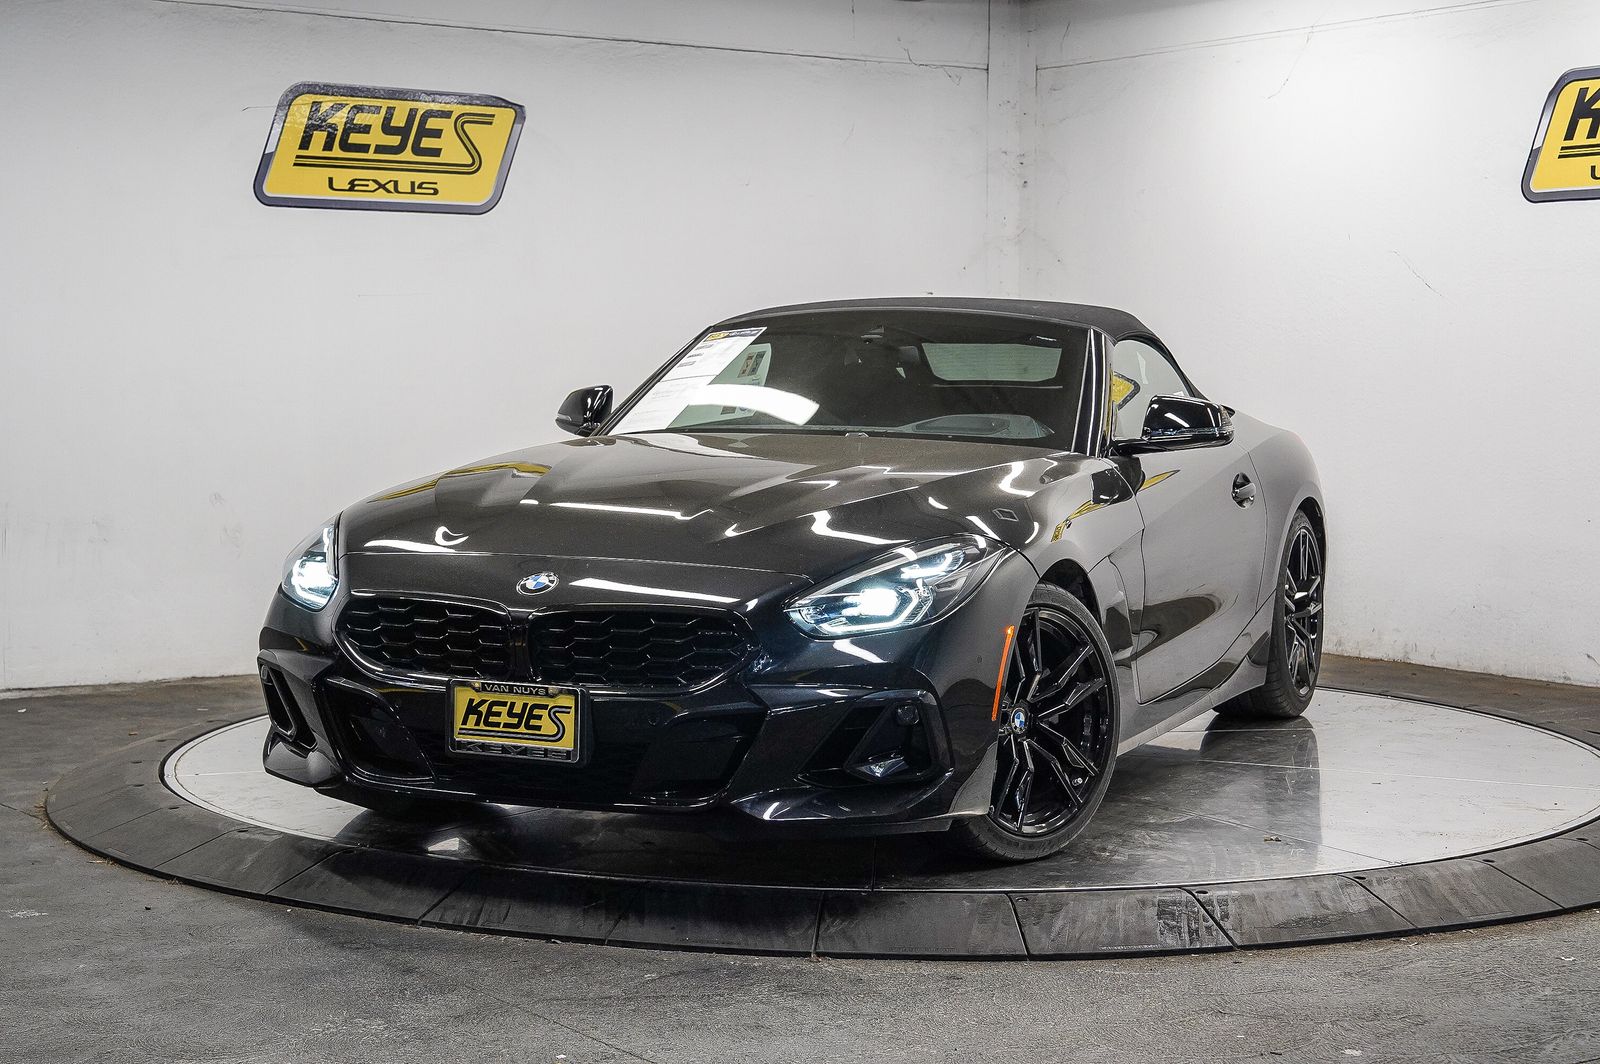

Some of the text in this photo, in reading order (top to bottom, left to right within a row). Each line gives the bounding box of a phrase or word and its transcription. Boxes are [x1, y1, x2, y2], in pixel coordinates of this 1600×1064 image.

[296, 100, 496, 175] KEYES
[327, 176, 440, 196] LEXUS
[484, 683, 546, 696] VAN NUYS
[458, 698, 572, 742] KEYES
